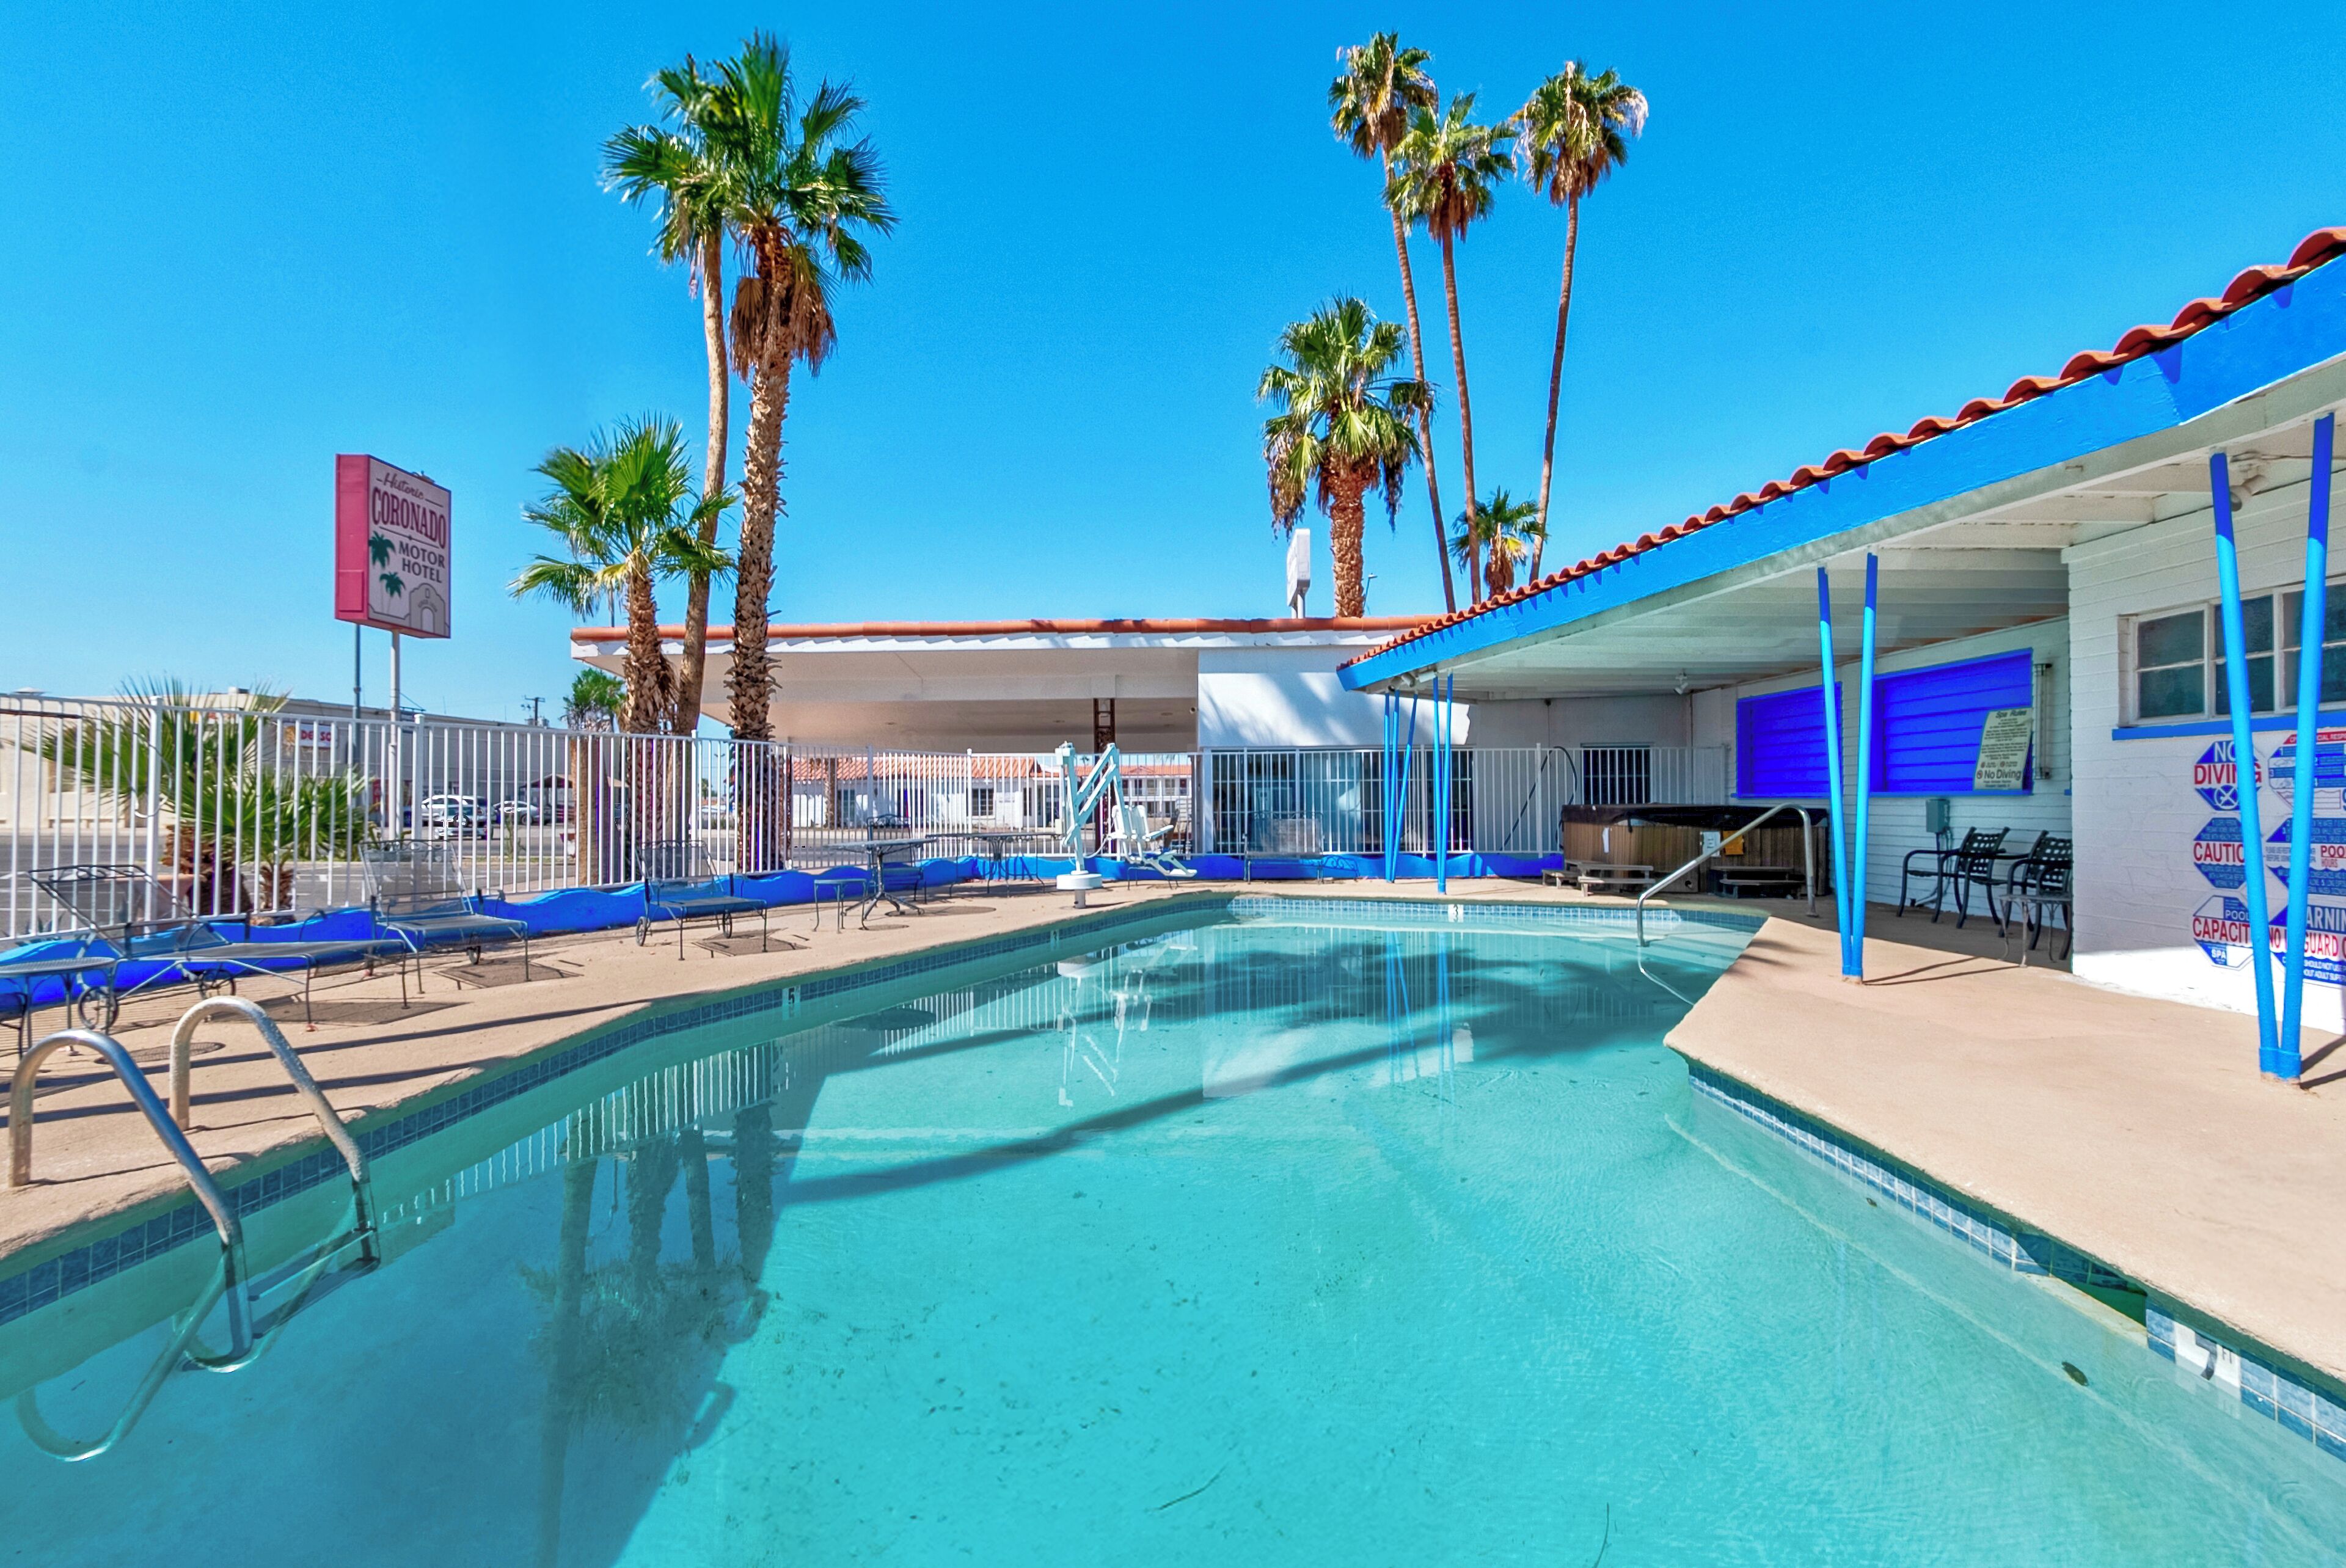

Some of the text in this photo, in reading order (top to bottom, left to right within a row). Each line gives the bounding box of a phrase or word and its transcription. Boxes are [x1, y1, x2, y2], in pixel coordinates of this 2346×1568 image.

[383, 472, 424, 499] Historic
[372, 487, 447, 549] CORONADO
[399, 541, 445, 569] MOTOR
[402, 558, 442, 583] HOTEL
[301, 729, 332, 742] DE SO
[1984, 769, 2022, 781] No Diving
[2193, 842, 2245, 863] CAUTIO
[2320, 845, 2346, 858] POO
[2225, 910, 2250, 921] POOL
[2193, 917, 2251, 944] CAPACIT
[2212, 948, 2226, 959] SPA
[788, 986, 795, 1005] 5
